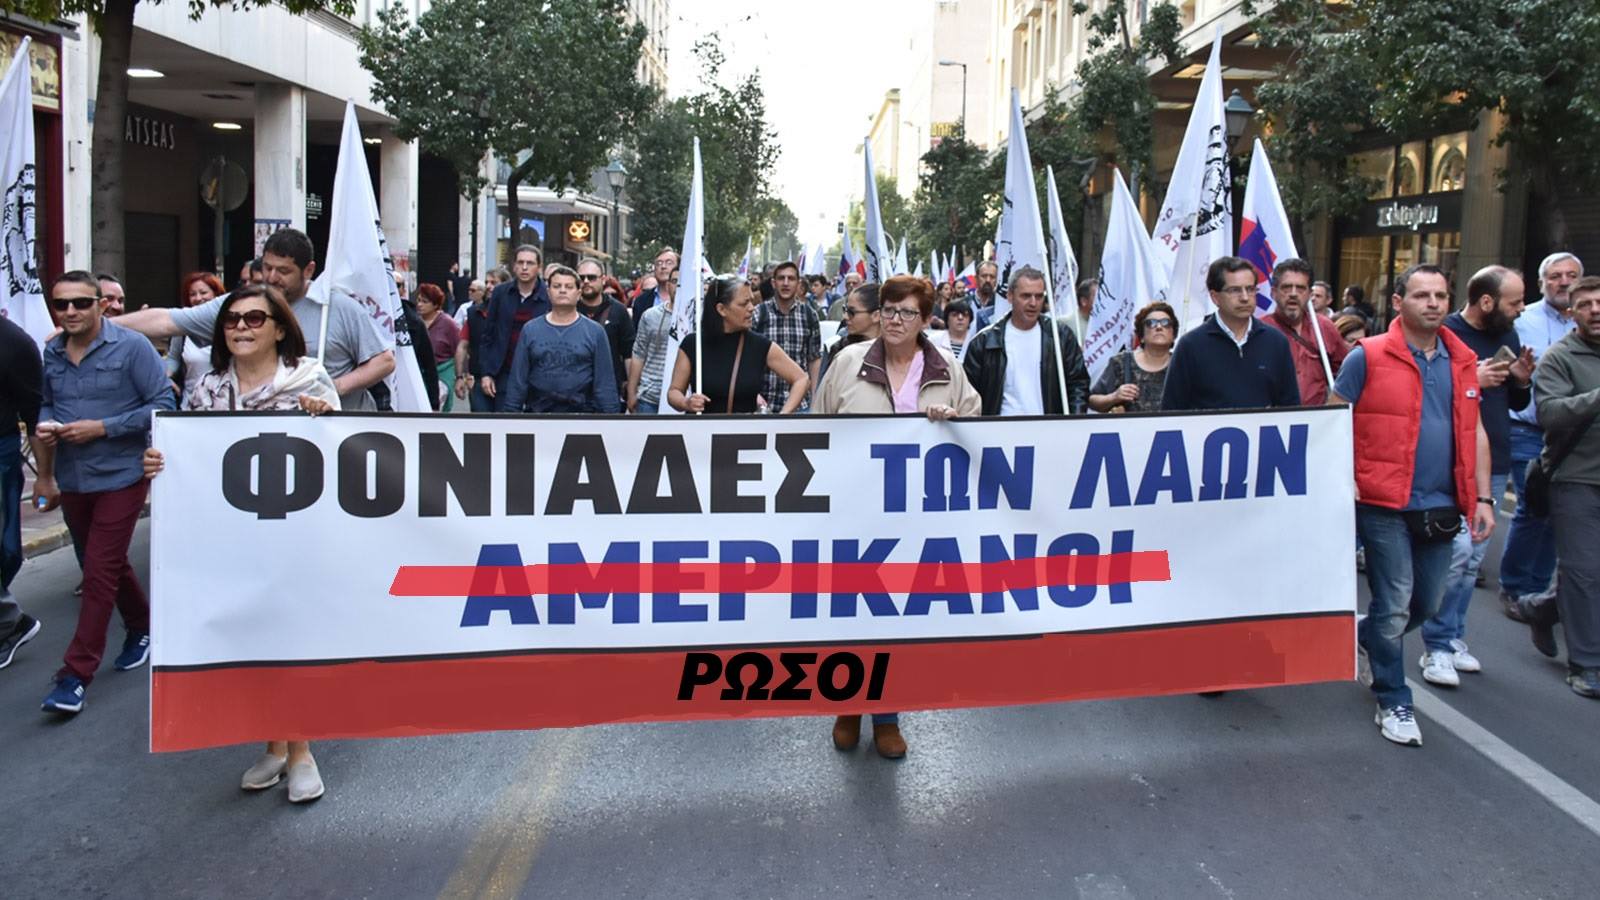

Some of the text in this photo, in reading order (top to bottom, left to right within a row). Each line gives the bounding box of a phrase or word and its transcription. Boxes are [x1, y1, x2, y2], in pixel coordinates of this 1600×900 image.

[222, 424, 1309, 520] ΦΟΝΙΑΔΕΣ ΤΩΝ ΛΑΩΝ
[459, 529, 1134, 628] ΑΜΕΡΙΚΑΝΟΙ
